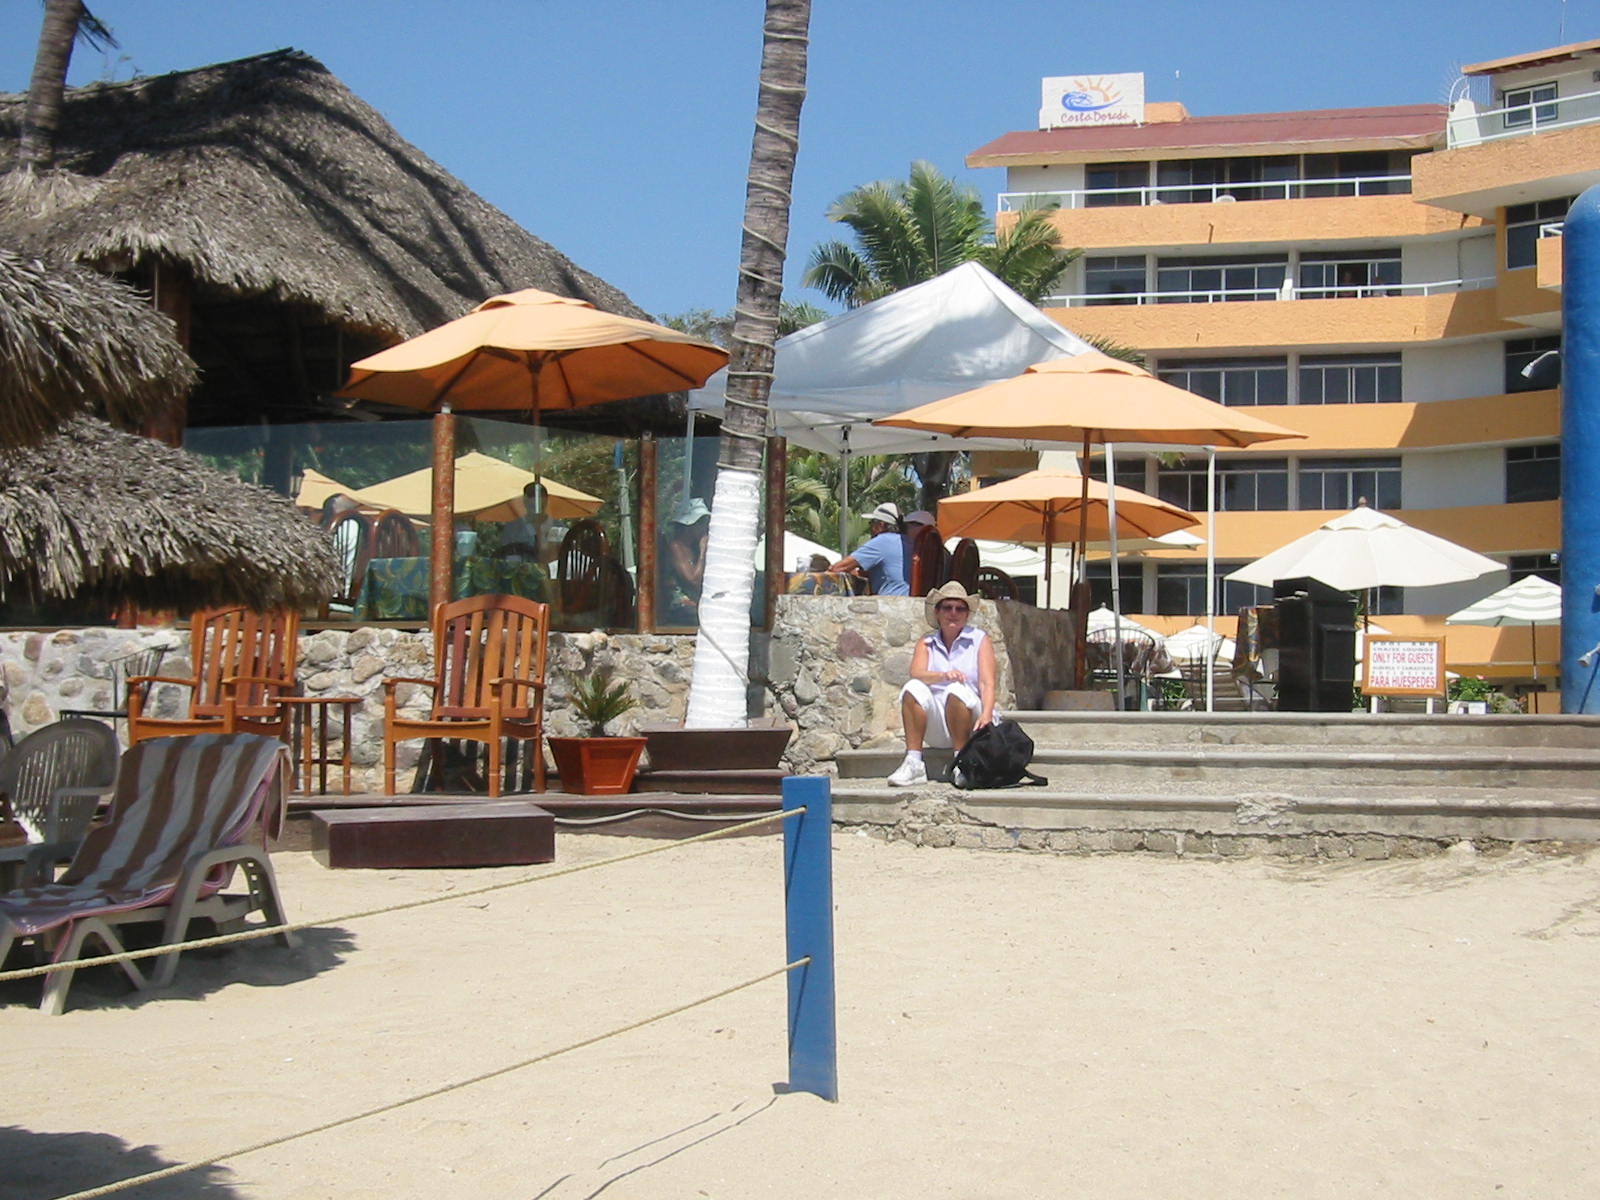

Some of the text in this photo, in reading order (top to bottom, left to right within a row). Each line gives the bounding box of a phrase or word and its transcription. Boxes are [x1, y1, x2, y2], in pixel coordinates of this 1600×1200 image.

[1061, 112, 1092, 123] Costa
[1373, 653, 1434, 663] ONLY FOR GUESTS
[1371, 677, 1435, 688] PARA HUESPEDES
